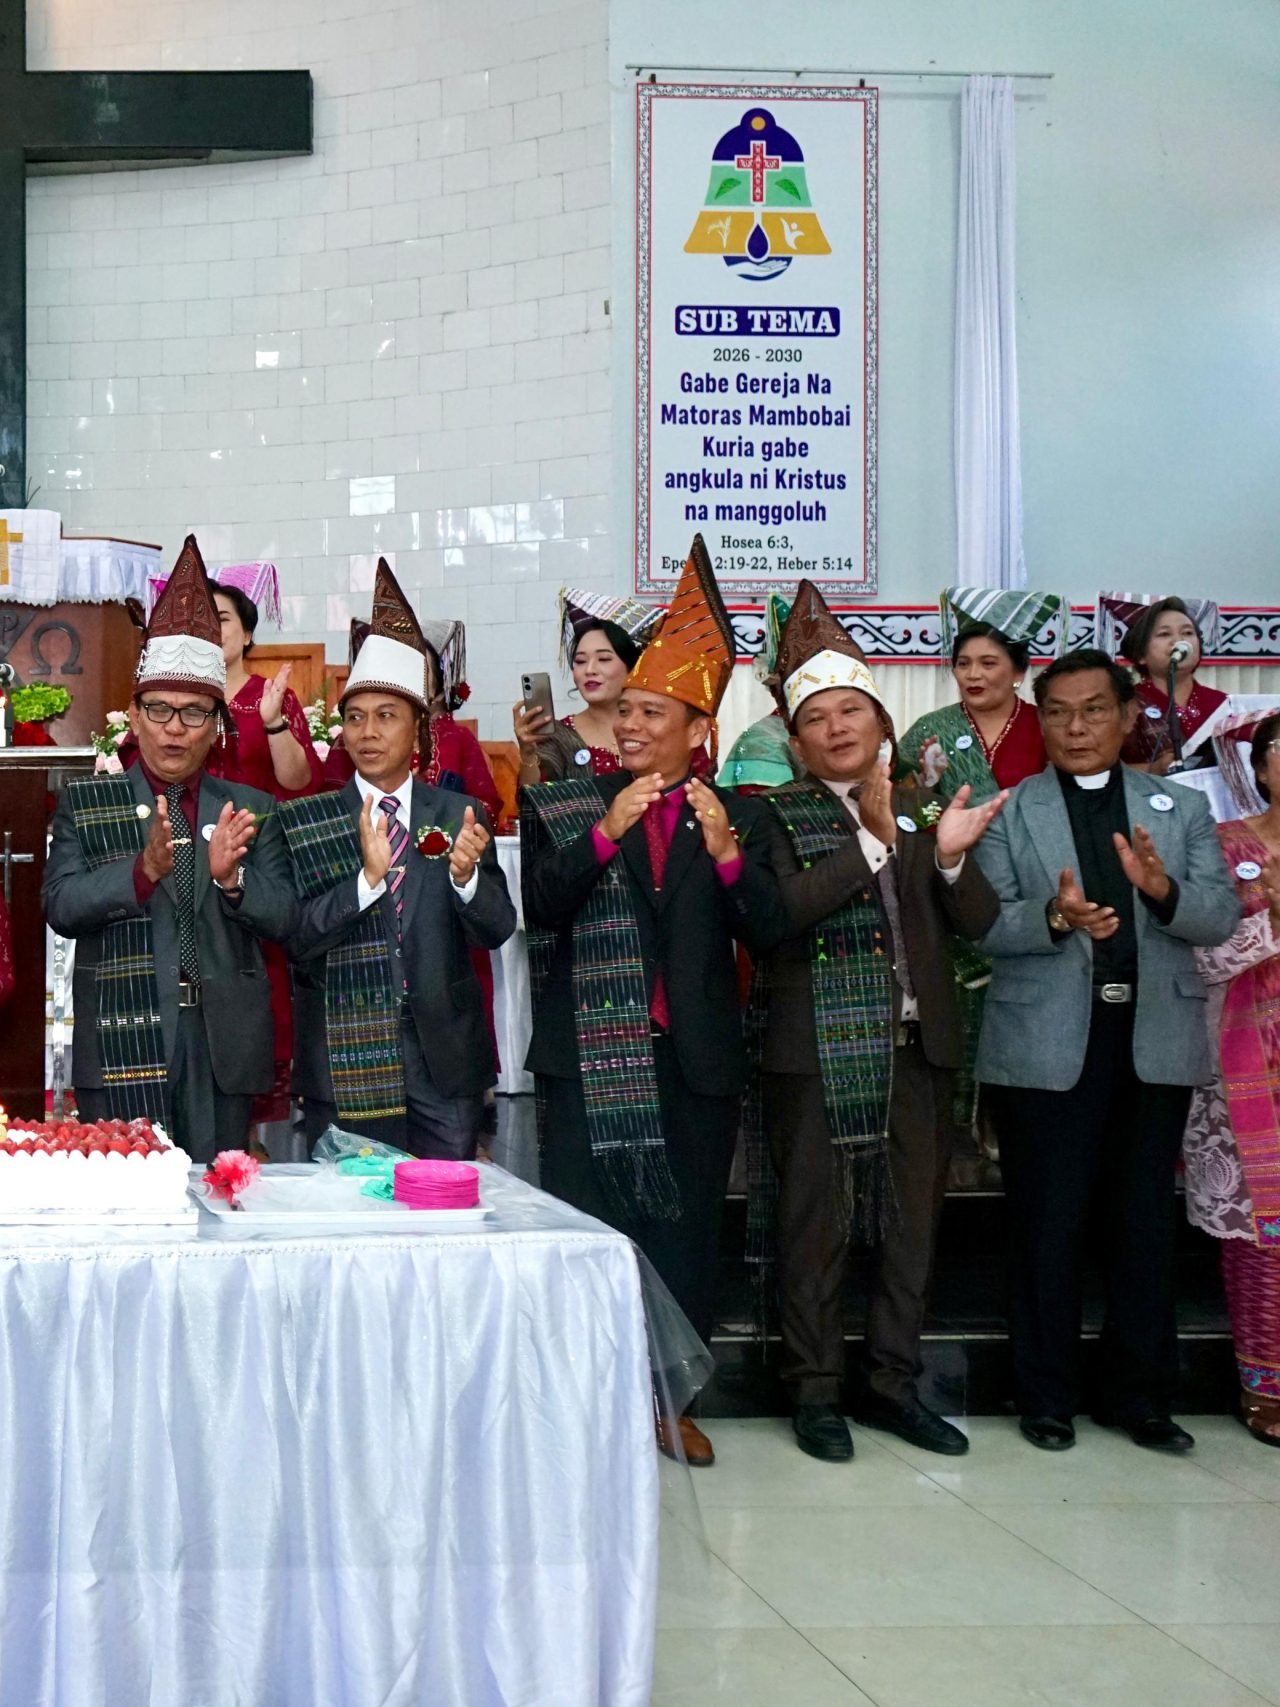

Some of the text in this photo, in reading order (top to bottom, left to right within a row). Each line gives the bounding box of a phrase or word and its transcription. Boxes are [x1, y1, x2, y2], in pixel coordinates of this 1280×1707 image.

[679, 308, 836, 333] SUB TEMA
[713, 348, 750, 362] 2026
[765, 348, 803, 363] 2030
[680, 372, 831, 399] Gabe Gereja Na
[661, 403, 851, 427] Matoras Mambobai
[703, 435, 809, 462] Kuria gabe
[664, 467, 847, 494] angkula ni Kristus
[685, 500, 827, 526] na manggoluh
[721, 535, 794, 552] Hosea 6:3,
[714, 556, 772, 572] 2:19-22,
[777, 556, 818, 571] Heber
[822, 556, 853, 571] 5:14
[29, 621, 84, 675] Ω
